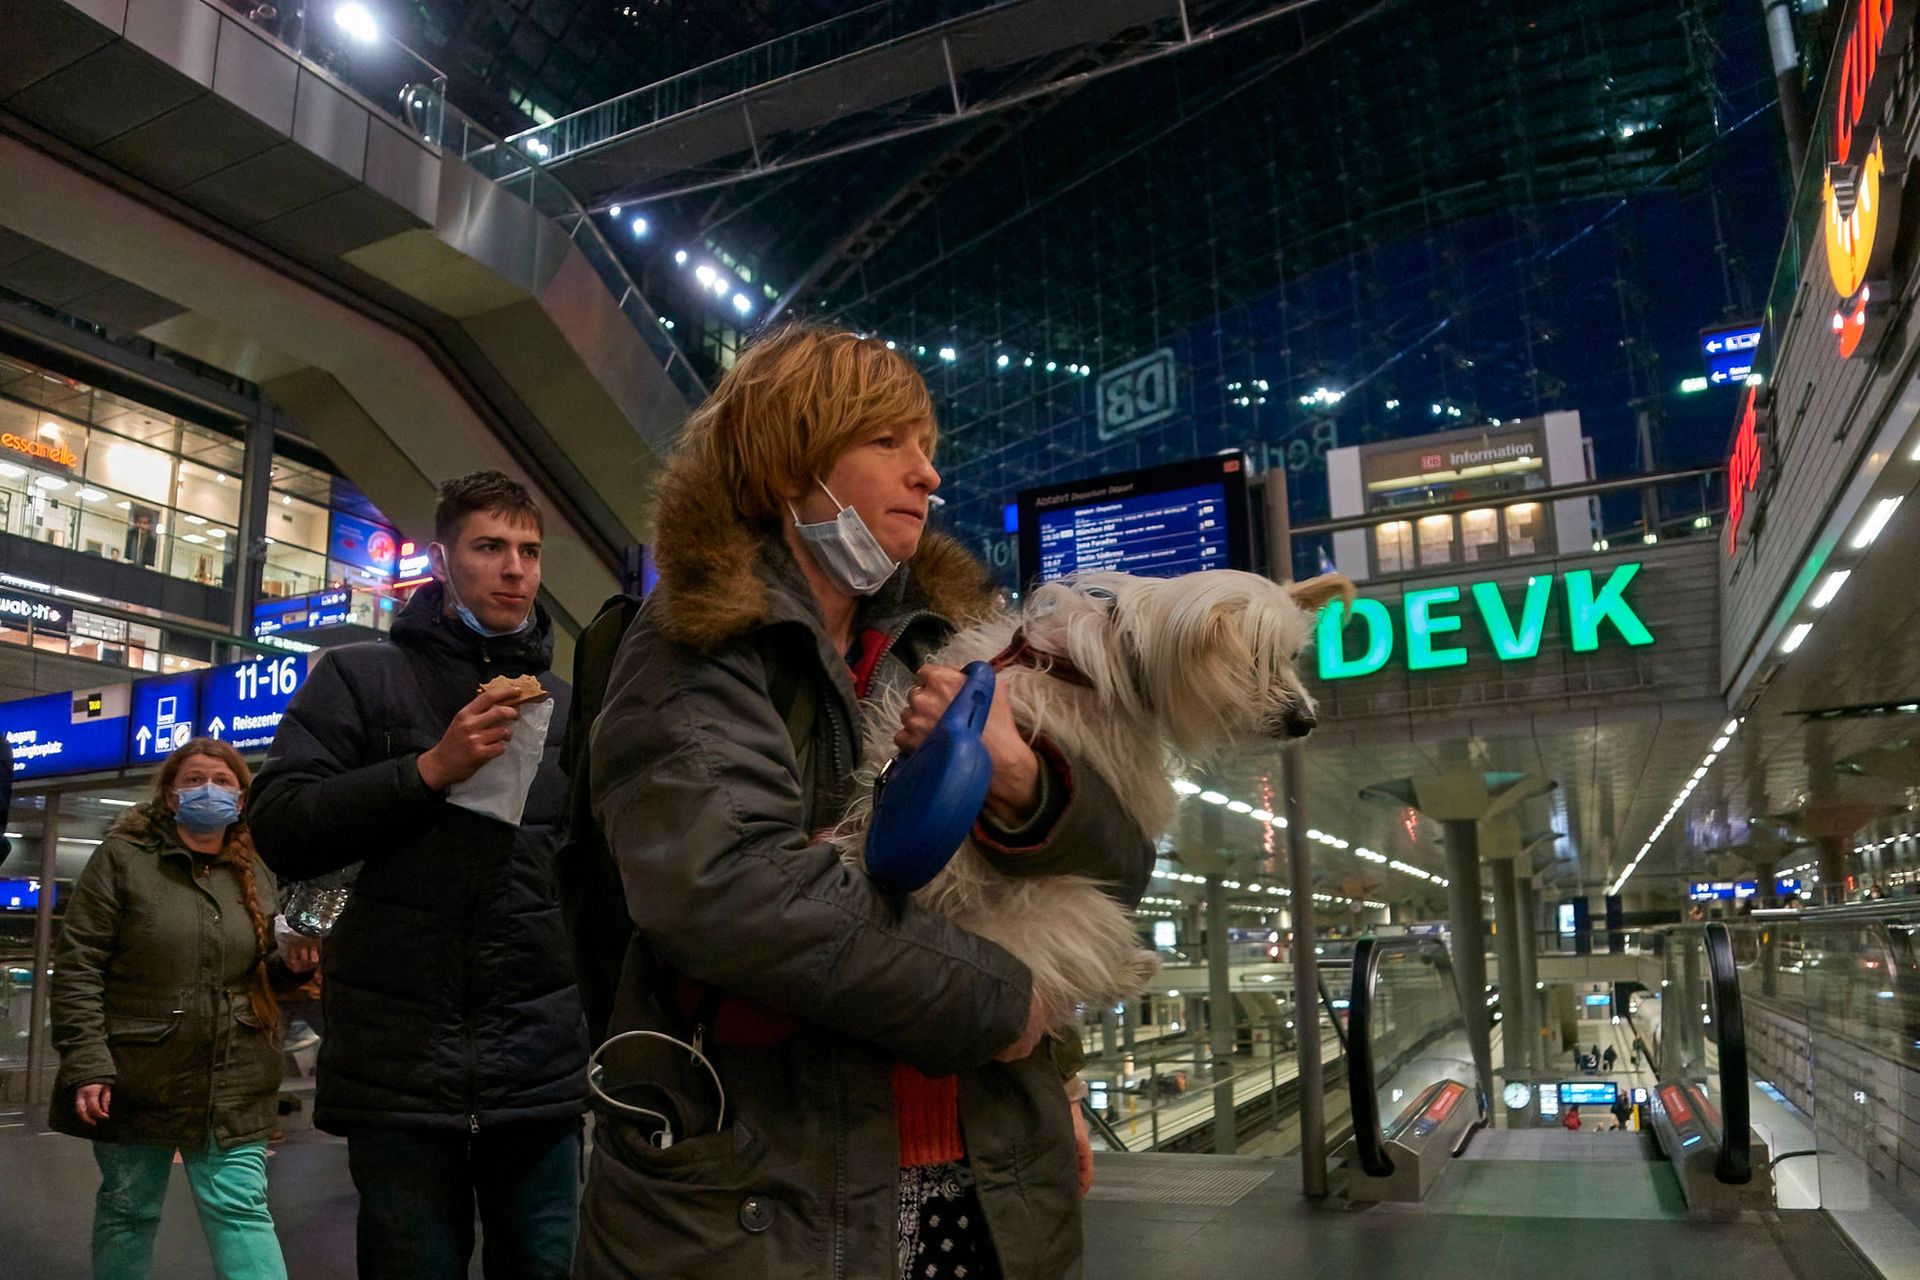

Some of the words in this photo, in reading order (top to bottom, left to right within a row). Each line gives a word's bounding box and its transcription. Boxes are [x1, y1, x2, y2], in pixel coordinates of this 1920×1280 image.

[1, 432, 78, 468] essanelle
[1449, 442, 1534, 466] Information
[1317, 562, 1655, 681] DEVK
[235, 655, 298, 701] 11-16
